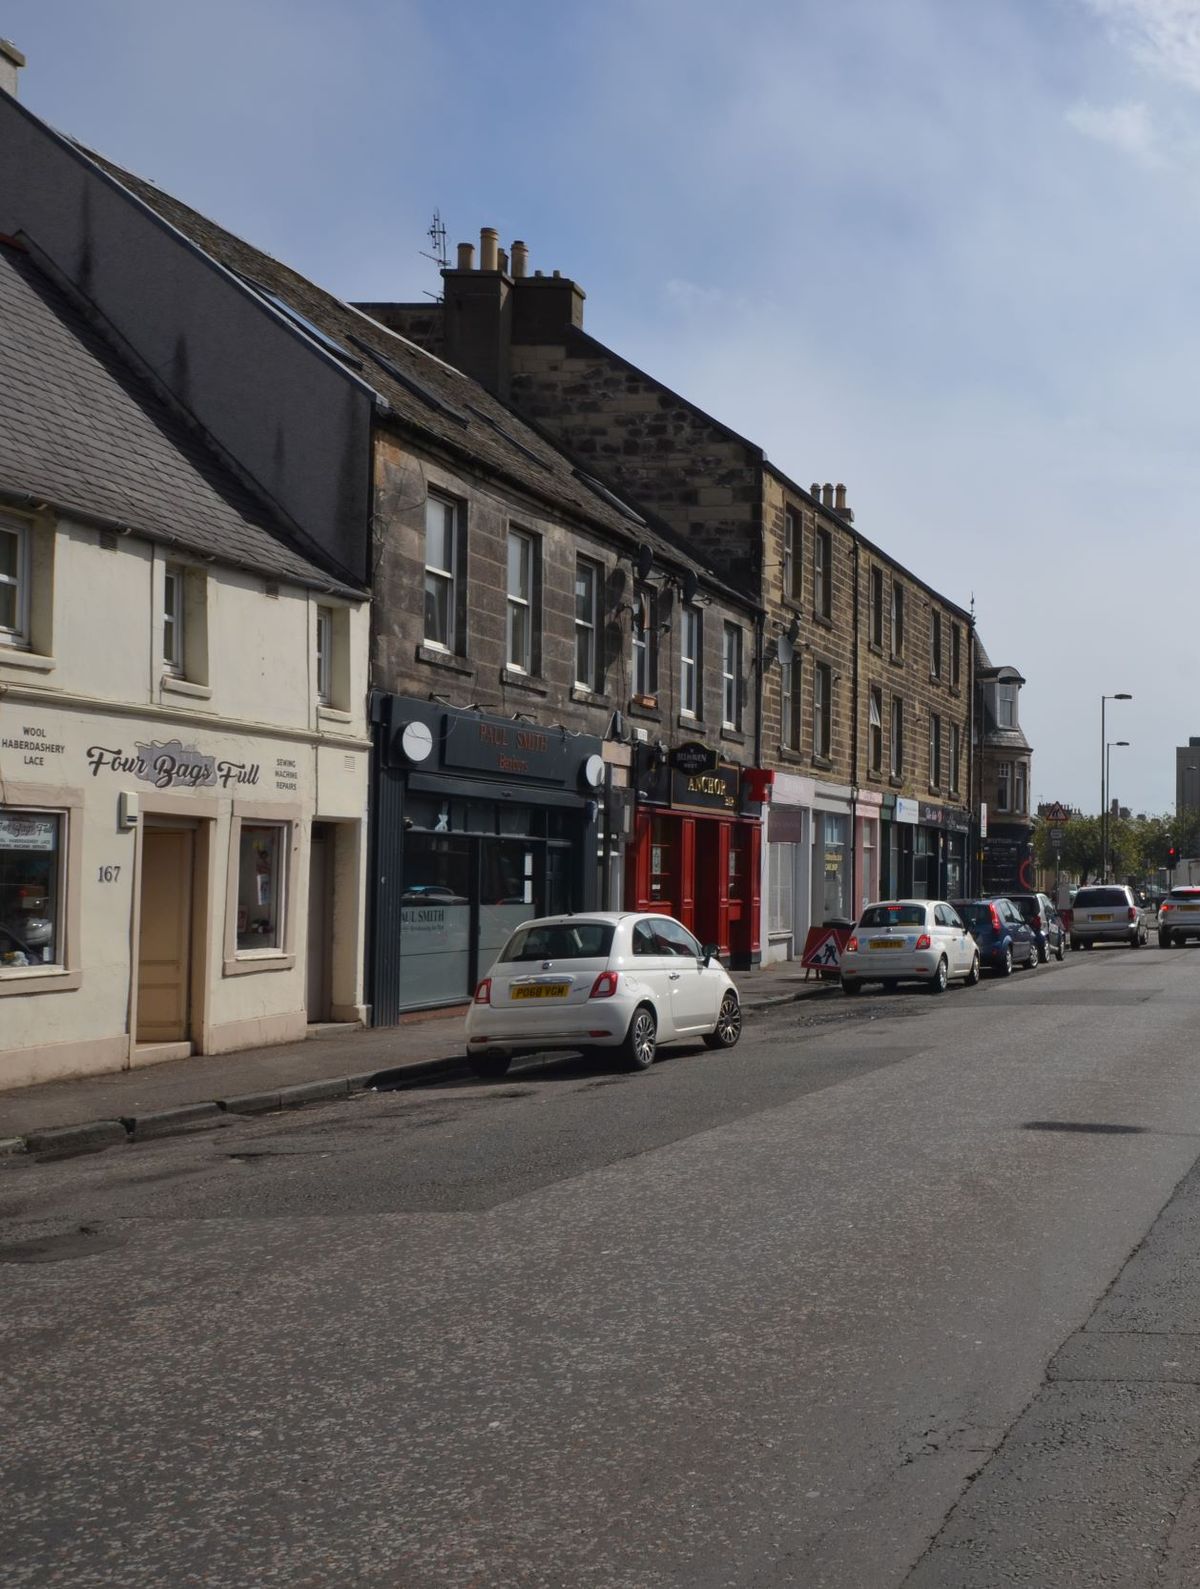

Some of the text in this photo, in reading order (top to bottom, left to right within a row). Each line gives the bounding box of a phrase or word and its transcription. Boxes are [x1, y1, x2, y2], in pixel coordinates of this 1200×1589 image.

[23, 726, 46, 738] WOOL
[479, 724, 549, 753] PAUL SMITH
[2, 738, 65, 754] HABERDASHERY
[24, 756, 44, 766] LACE
[87, 745, 260, 788] Four Bags Full
[276, 758, 296, 768] SEWING
[274, 770, 298, 780] MACHINE
[276, 781, 297, 791] REPAIRS
[97, 865, 121, 883] 167
[418, 909, 445, 923] SMITH
